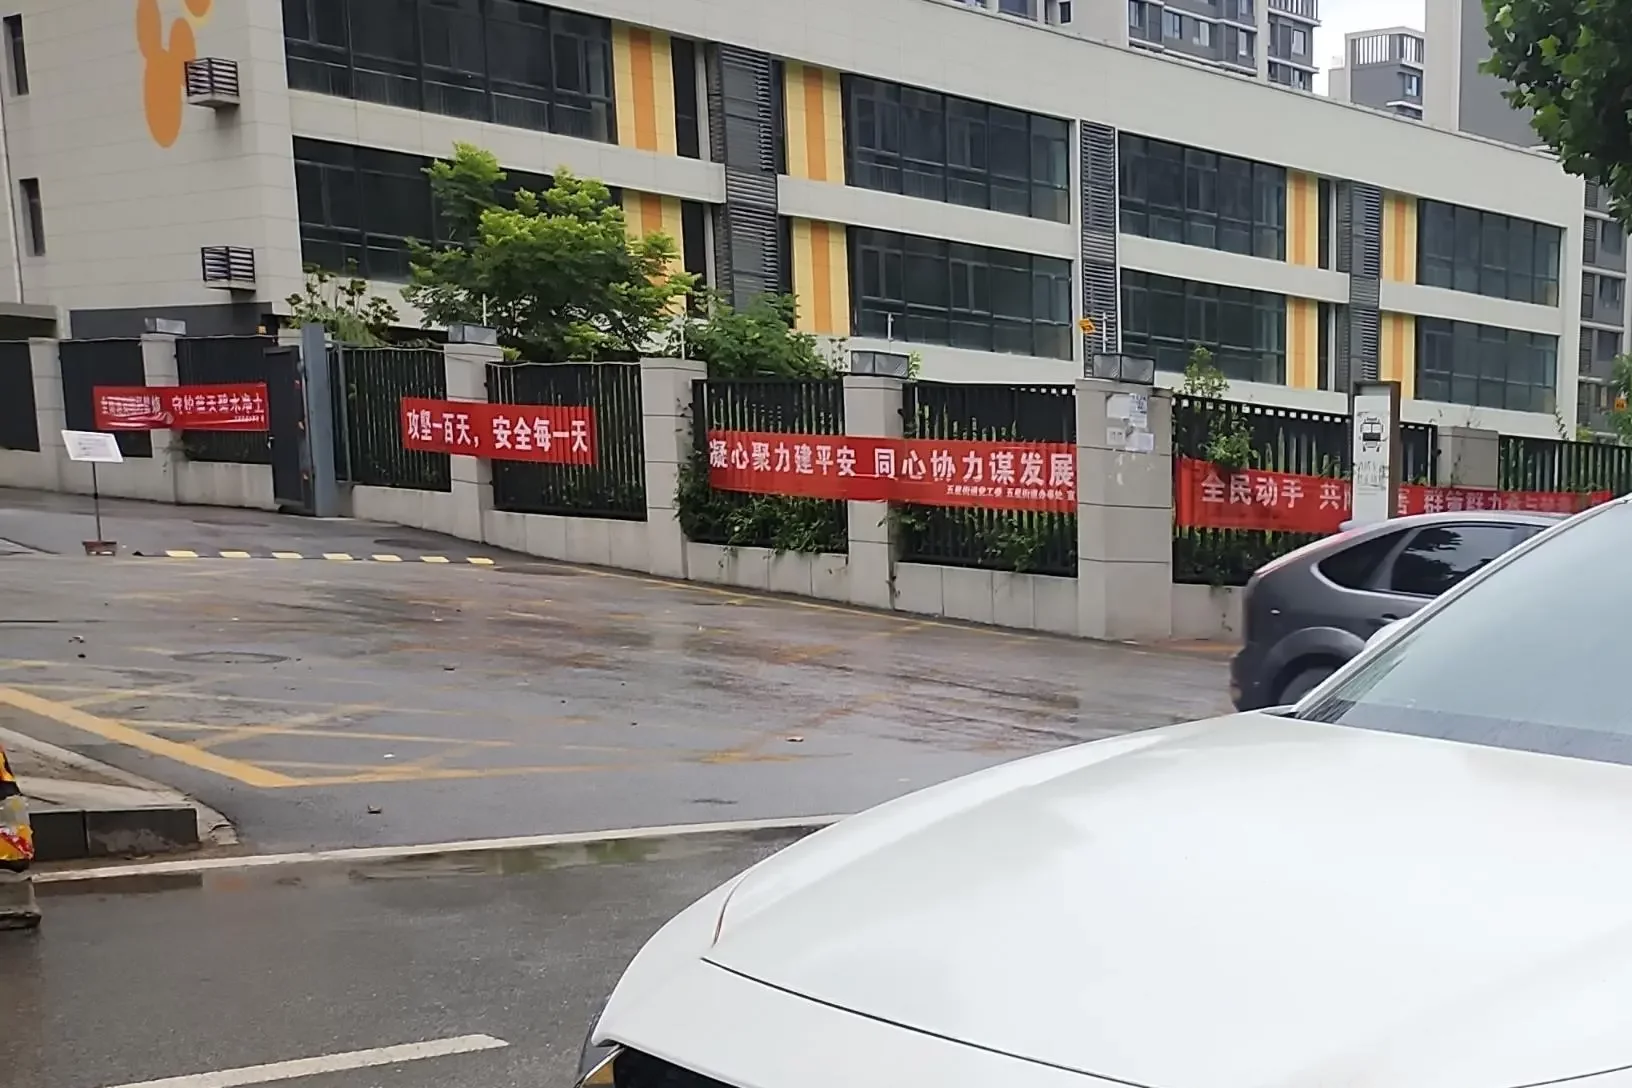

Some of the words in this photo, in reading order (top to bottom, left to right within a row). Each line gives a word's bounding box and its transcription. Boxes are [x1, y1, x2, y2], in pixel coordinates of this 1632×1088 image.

[492, 415, 588, 452] 安全每一天
[709, 438, 857, 477] 凝心聚力建平安
[874, 448, 1075, 487] 同心协力谋发展
[1201, 472, 1304, 508] 全民动手
